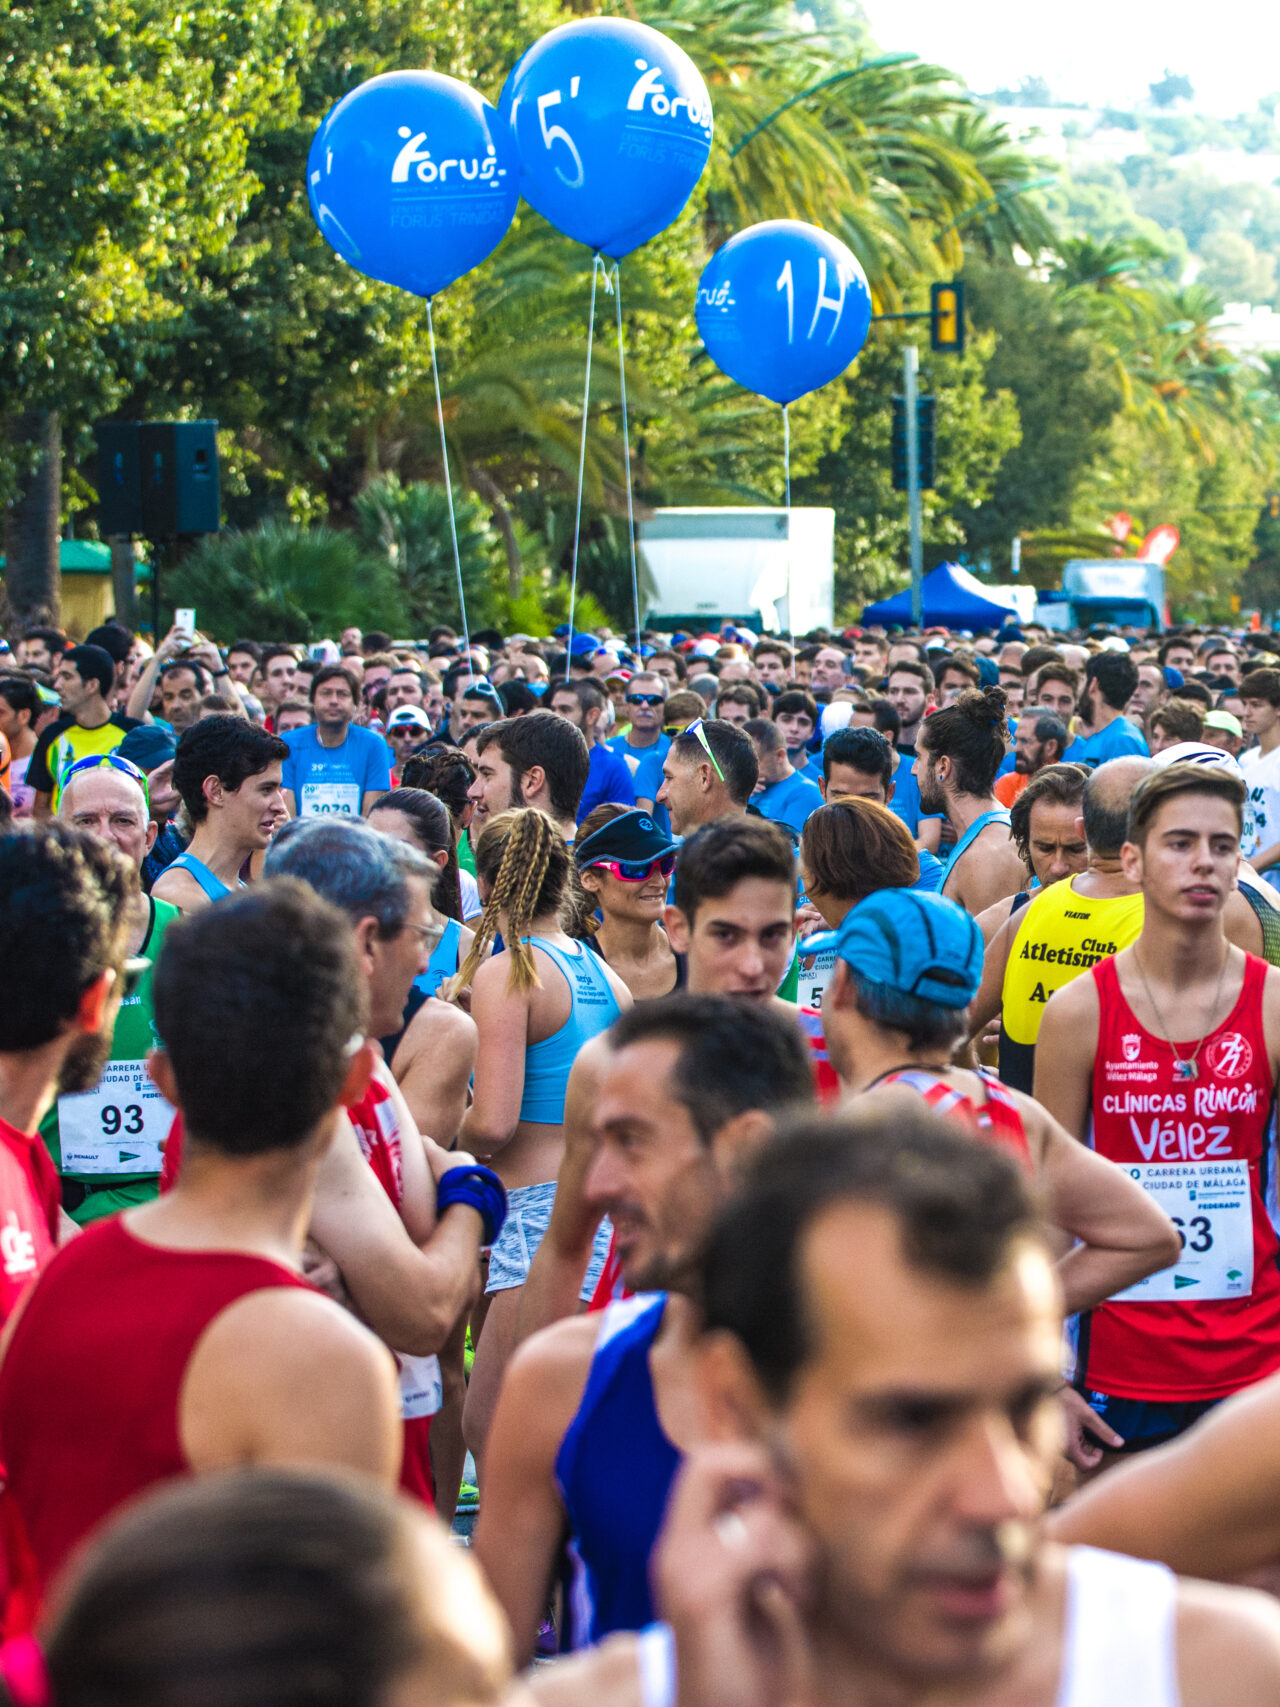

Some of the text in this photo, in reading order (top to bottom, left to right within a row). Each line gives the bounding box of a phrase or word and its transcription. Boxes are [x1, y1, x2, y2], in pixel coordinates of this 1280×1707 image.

[537, 76, 584, 188] 5'
[1063, 910, 1091, 920] VIATOR
[1020, 940, 1102, 968] Atletism
[1081, 938, 1117, 955] Club
[133, 1074, 143, 1082] DE
[1102, 1091, 1186, 1114] CLÍNICAS
[101, 1104, 144, 1135] 93
[1129, 1115, 1233, 1161] Vélez
[1147, 1166, 1242, 1177] CARRERA URBANA
[1143, 1178, 1247, 1190] CIUDAD DE MÁLAGA
[1198, 1202, 1240, 1210] FEDERADO
